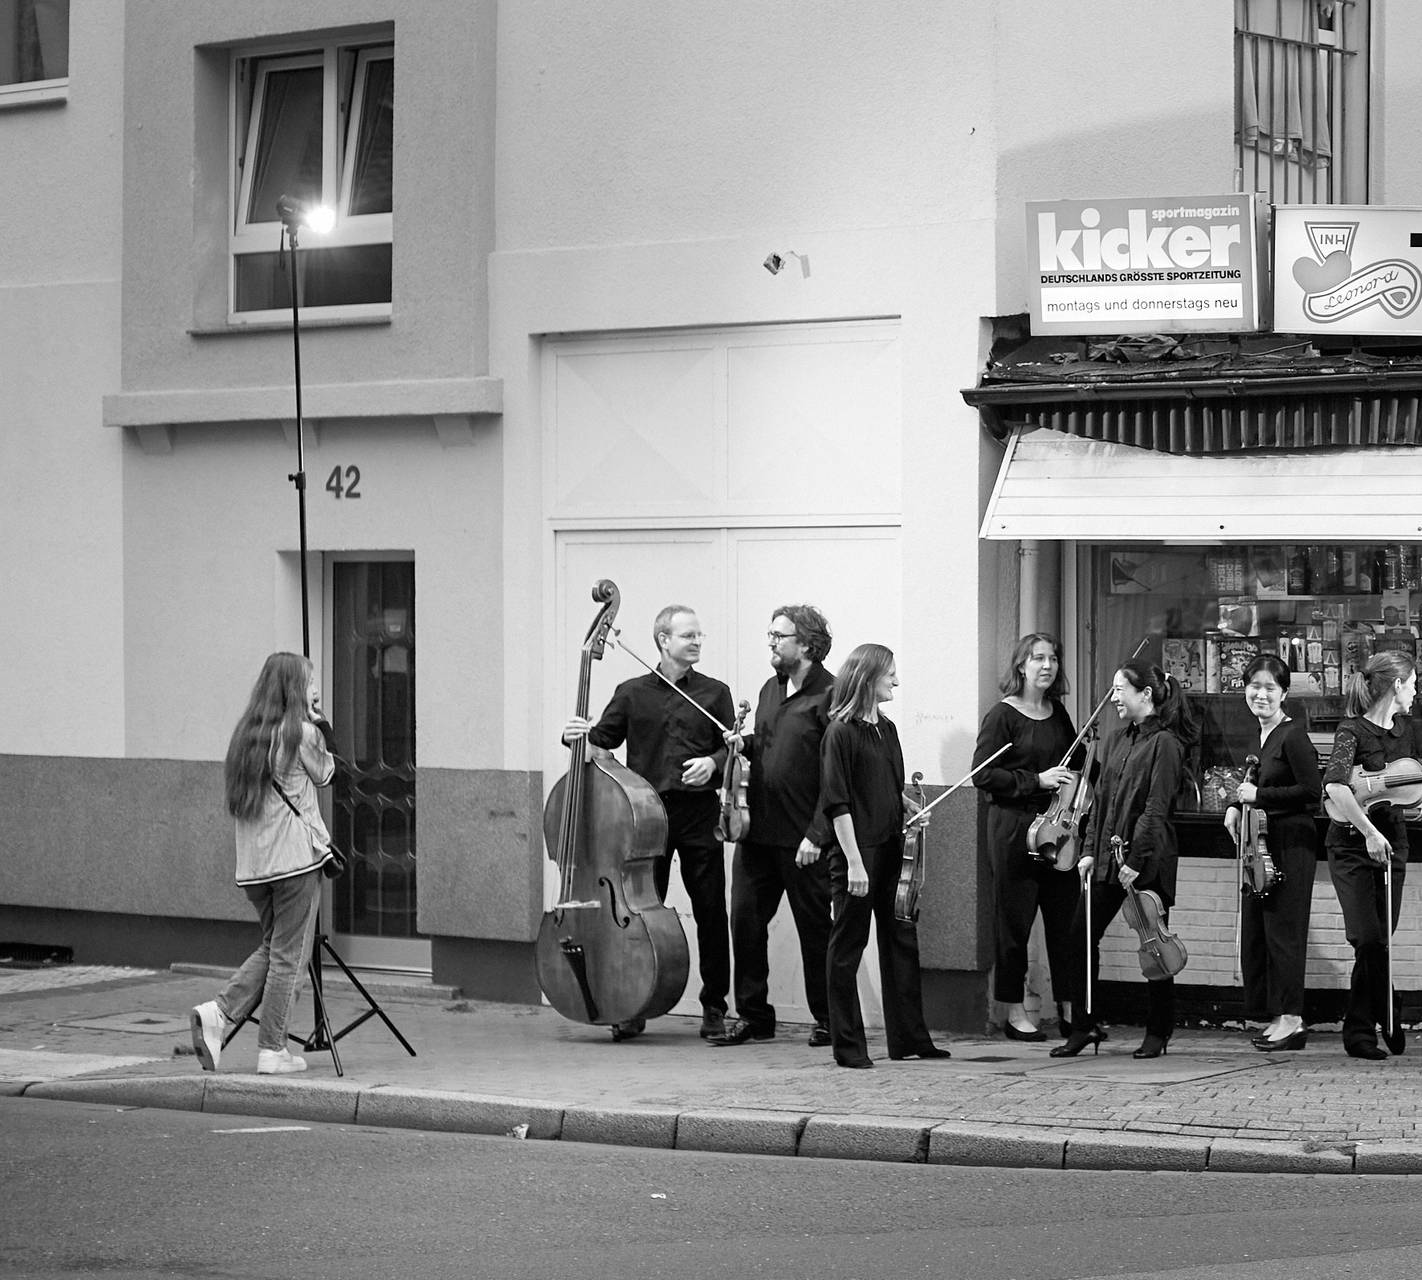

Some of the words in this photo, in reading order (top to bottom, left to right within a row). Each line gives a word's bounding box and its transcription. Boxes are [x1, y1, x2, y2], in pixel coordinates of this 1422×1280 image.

[1152, 205, 1240, 221] sportmagazin
[1038, 207, 1241, 271] kicker
[1319, 233, 1345, 246] INH
[1041, 272, 1118, 284] DEUTSCHLANDS
[1120, 271, 1165, 281] GRÖSSTE
[1167, 269, 1241, 281] SPORTZEITUNG
[1047, 300, 1100, 314] montags
[1105, 299, 1128, 309] und
[1133, 298, 1210, 312] donnerstags
[1215, 299, 1238, 308] neu
[326, 465, 360, 499] 42
